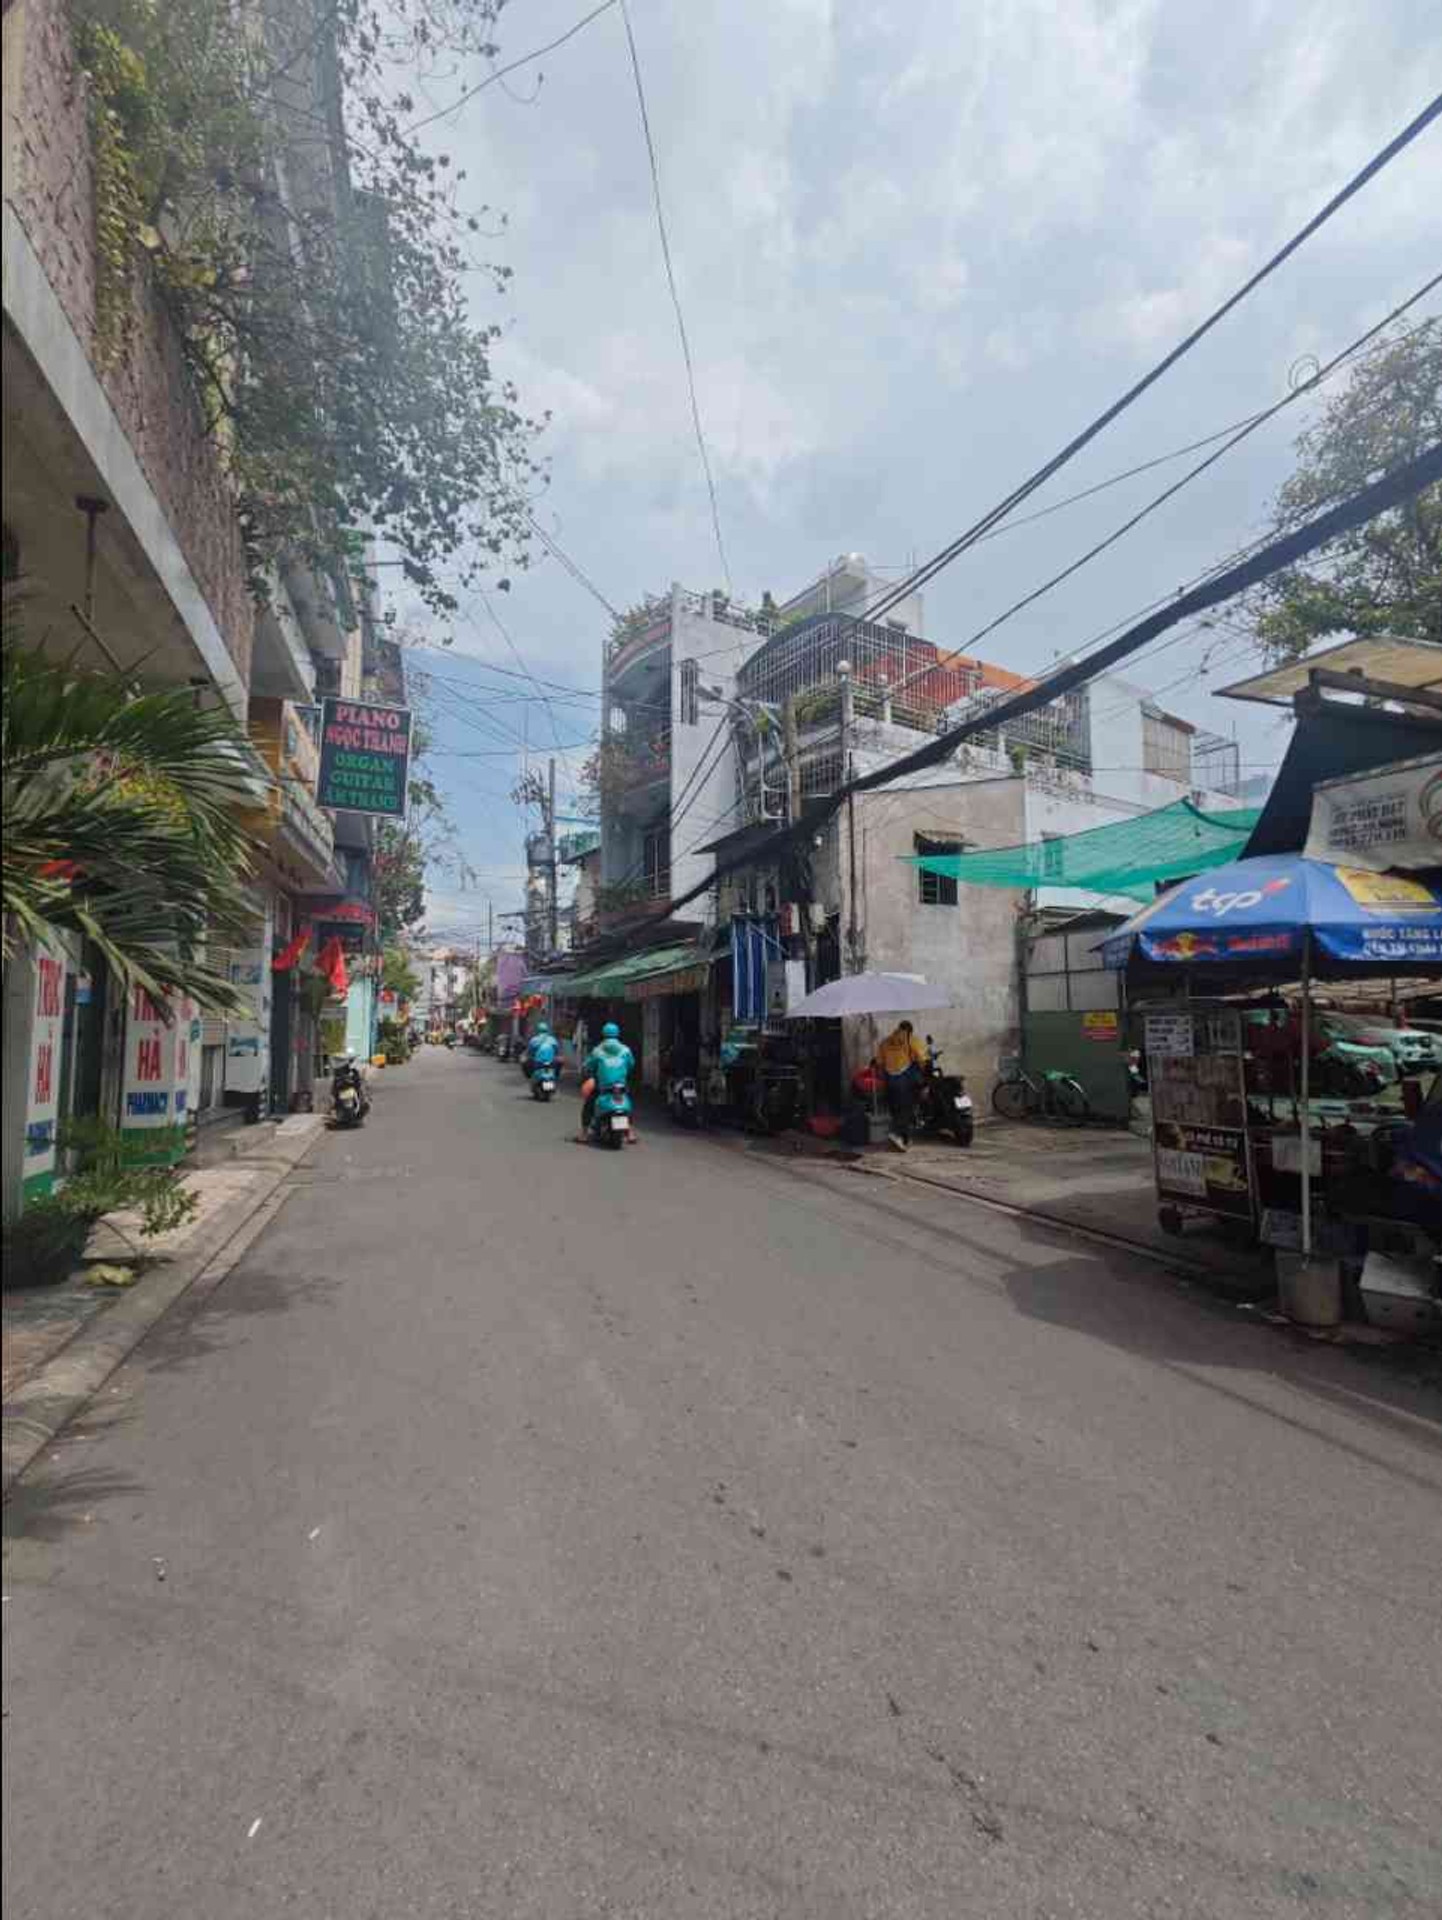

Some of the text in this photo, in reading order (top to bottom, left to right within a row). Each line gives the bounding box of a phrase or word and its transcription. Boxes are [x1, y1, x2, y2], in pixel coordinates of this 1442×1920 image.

[336, 703, 400, 730] PIANO
[335, 752, 395, 772] ORGAN
[330, 768, 396, 792] GUITAR
[1190, 887, 1263, 918] tcp
